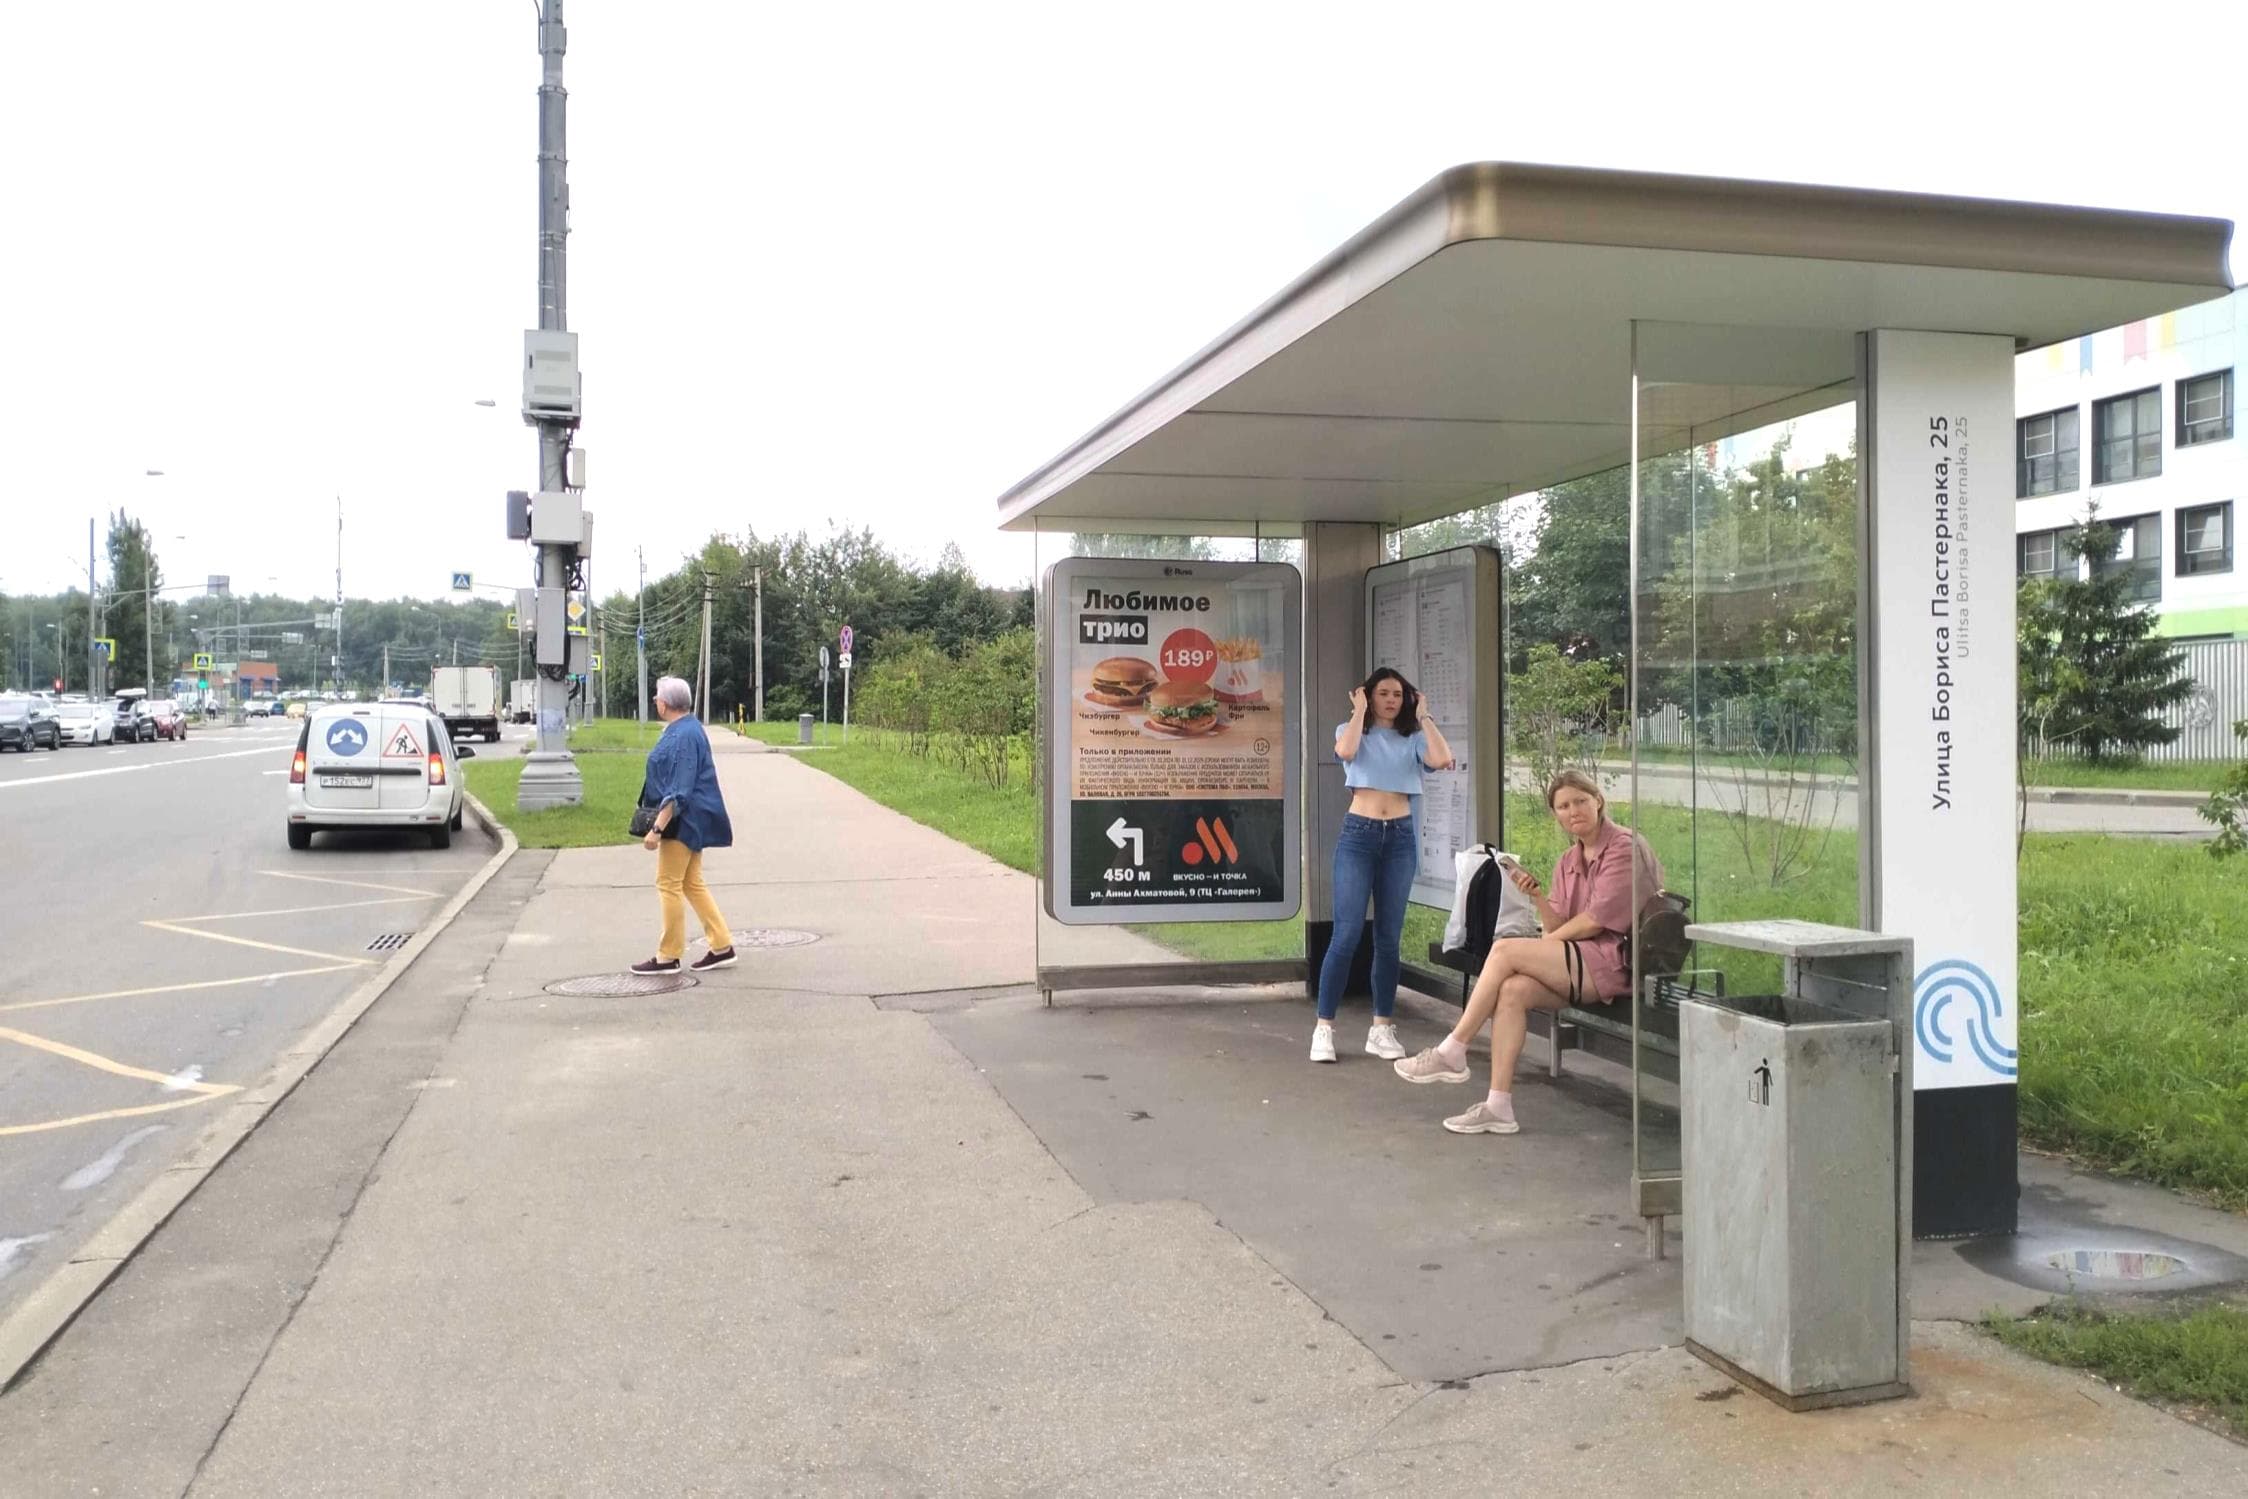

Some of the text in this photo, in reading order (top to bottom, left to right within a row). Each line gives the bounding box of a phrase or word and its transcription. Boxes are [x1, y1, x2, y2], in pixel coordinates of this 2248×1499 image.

[1955, 416, 1969, 658] Ulitsa Borisa Pasternaka, 25
[1083, 588, 1211, 612] Любимое
[1930, 416, 1953, 810] Улица Бориса Пастернака, 25
[1083, 621, 1146, 642] трио
[1228, 702, 1270, 712] Картофель
[1079, 711, 1120, 721] Чизбургер
[1228, 712, 1245, 720] Фри
[1089, 727, 1140, 737] Чикенбургер
[1079, 747, 1110, 755] Только
[1118, 747, 1172, 757] приложении
[1103, 868, 1151, 882] 450 м
[1172, 873, 1205, 882] ВКУСНО
[1213, 873, 1219, 881] И
[1221, 872, 1248, 881] ТОЧКА
[1090, 890, 1104, 900] ул.
[1105, 889, 1132, 898] Анны
[1133, 887, 1187, 898] Ахматовой,
[1189, 887, 1196, 896] 9
[1197, 887, 1213, 898] (ТЦ
